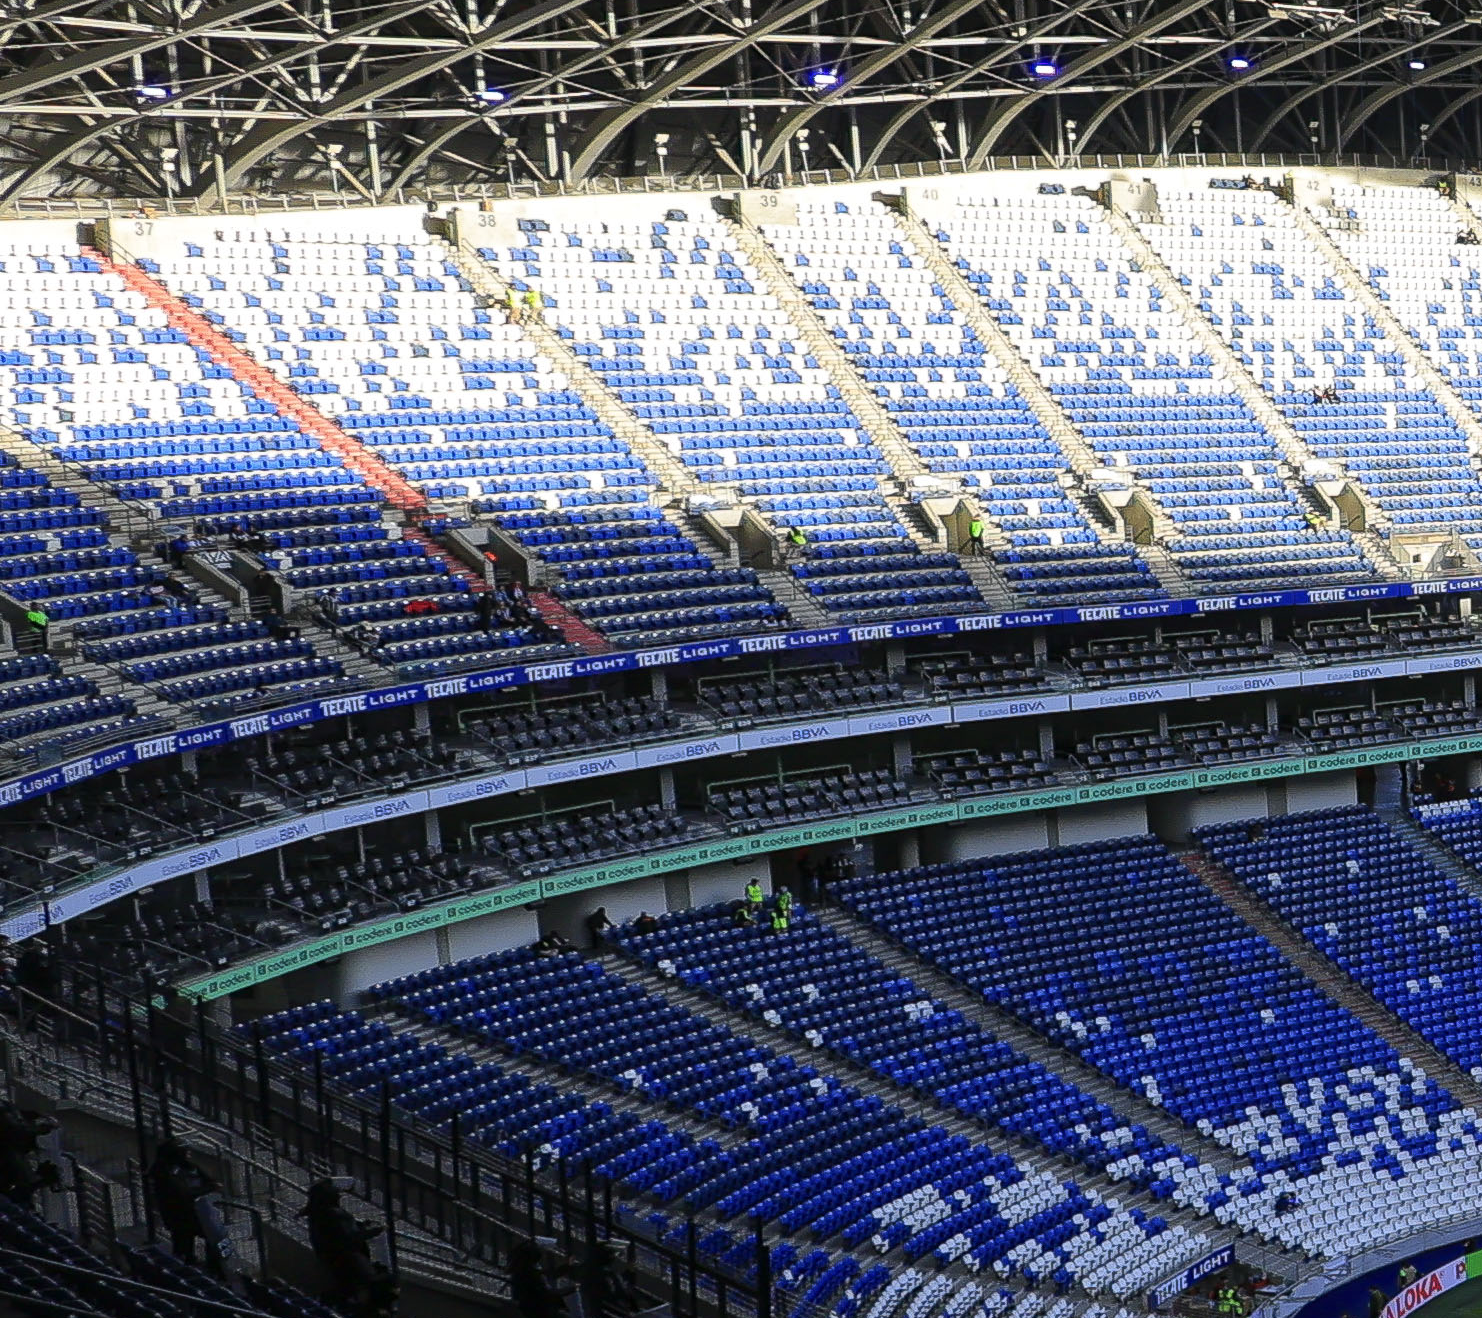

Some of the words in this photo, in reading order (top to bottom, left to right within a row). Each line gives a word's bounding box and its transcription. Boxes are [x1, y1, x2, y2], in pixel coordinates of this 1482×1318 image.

[1307, 588, 1347, 604] TECATE
[1347, 587, 1389, 600] LIGHT
[1411, 581, 1449, 595] TECATE
[1196, 596, 1238, 613] TECATE
[1239, 594, 1283, 608] LIGHT
[1077, 604, 1121, 622] TECATE
[1122, 603, 1171, 617] LIGHT
[956, 615, 1002, 631] TECATE
[1005, 612, 1054, 626] LIGHT
[847, 625, 893, 644] TECATE
[896, 621, 944, 635] LIGHT
[738, 634, 787, 654] TECATE
[790, 631, 840, 646] LIGHT
[635, 647, 681, 668] TECATE
[683, 643, 730, 659] LIGHT
[1453, 656, 1481, 668] BBVA
[524, 661, 574, 683] TECATE
[575, 657, 626, 674] LIGHT
[1352, 666, 1383, 679] BBVA
[424, 678, 468, 699] TECATE
[470, 671, 515, 689] LIGHT
[1243, 677, 1276, 690] BBVA
[320, 695, 368, 717] TECATE
[369, 688, 419, 706] LIGHT
[1128, 688, 1162, 703] BBVA
[1009, 701, 1046, 714] BBVA
[229, 715, 272, 739] TECATE
[272, 707, 312, 726] LIGHT
[897, 713, 933, 728] BBVA
[792, 726, 830, 742] BBVA
[134, 735, 177, 761] TECATE
[178, 728, 223, 747] LIGHT
[685, 741, 721, 757] BBVA
[1423, 742, 1458, 755] codere
[1319, 755, 1355, 768] codere
[1368, 749, 1404, 763] codere
[62, 757, 94, 783] TECATE
[95, 750, 128, 772] LIGHT
[579, 759, 618, 776] BBVA
[1263, 763, 1300, 776] codere
[24, 772, 60, 796] LIGHT
[1210, 769, 1248, 782] codere
[475, 777, 506, 797] BBVA
[1092, 784, 1134, 799] codere
[1149, 777, 1190, 792] codere
[1032, 791, 1072, 807] codere
[374, 800, 410, 818] BBVA
[919, 809, 955, 824] codere
[279, 823, 309, 841] BBVA
[870, 816, 907, 833] codere
[761, 833, 800, 851] codere
[814, 825, 853, 842] codere
[189, 848, 222, 869] BBVA
[710, 843, 744, 860] codere
[661, 852, 697, 870] codere
[607, 862, 646, 881] codere
[555, 873, 593, 892] codere
[1192, 1250, 1231, 1280] LIGHT
[1396, 1273, 1442, 1318] LOKA
